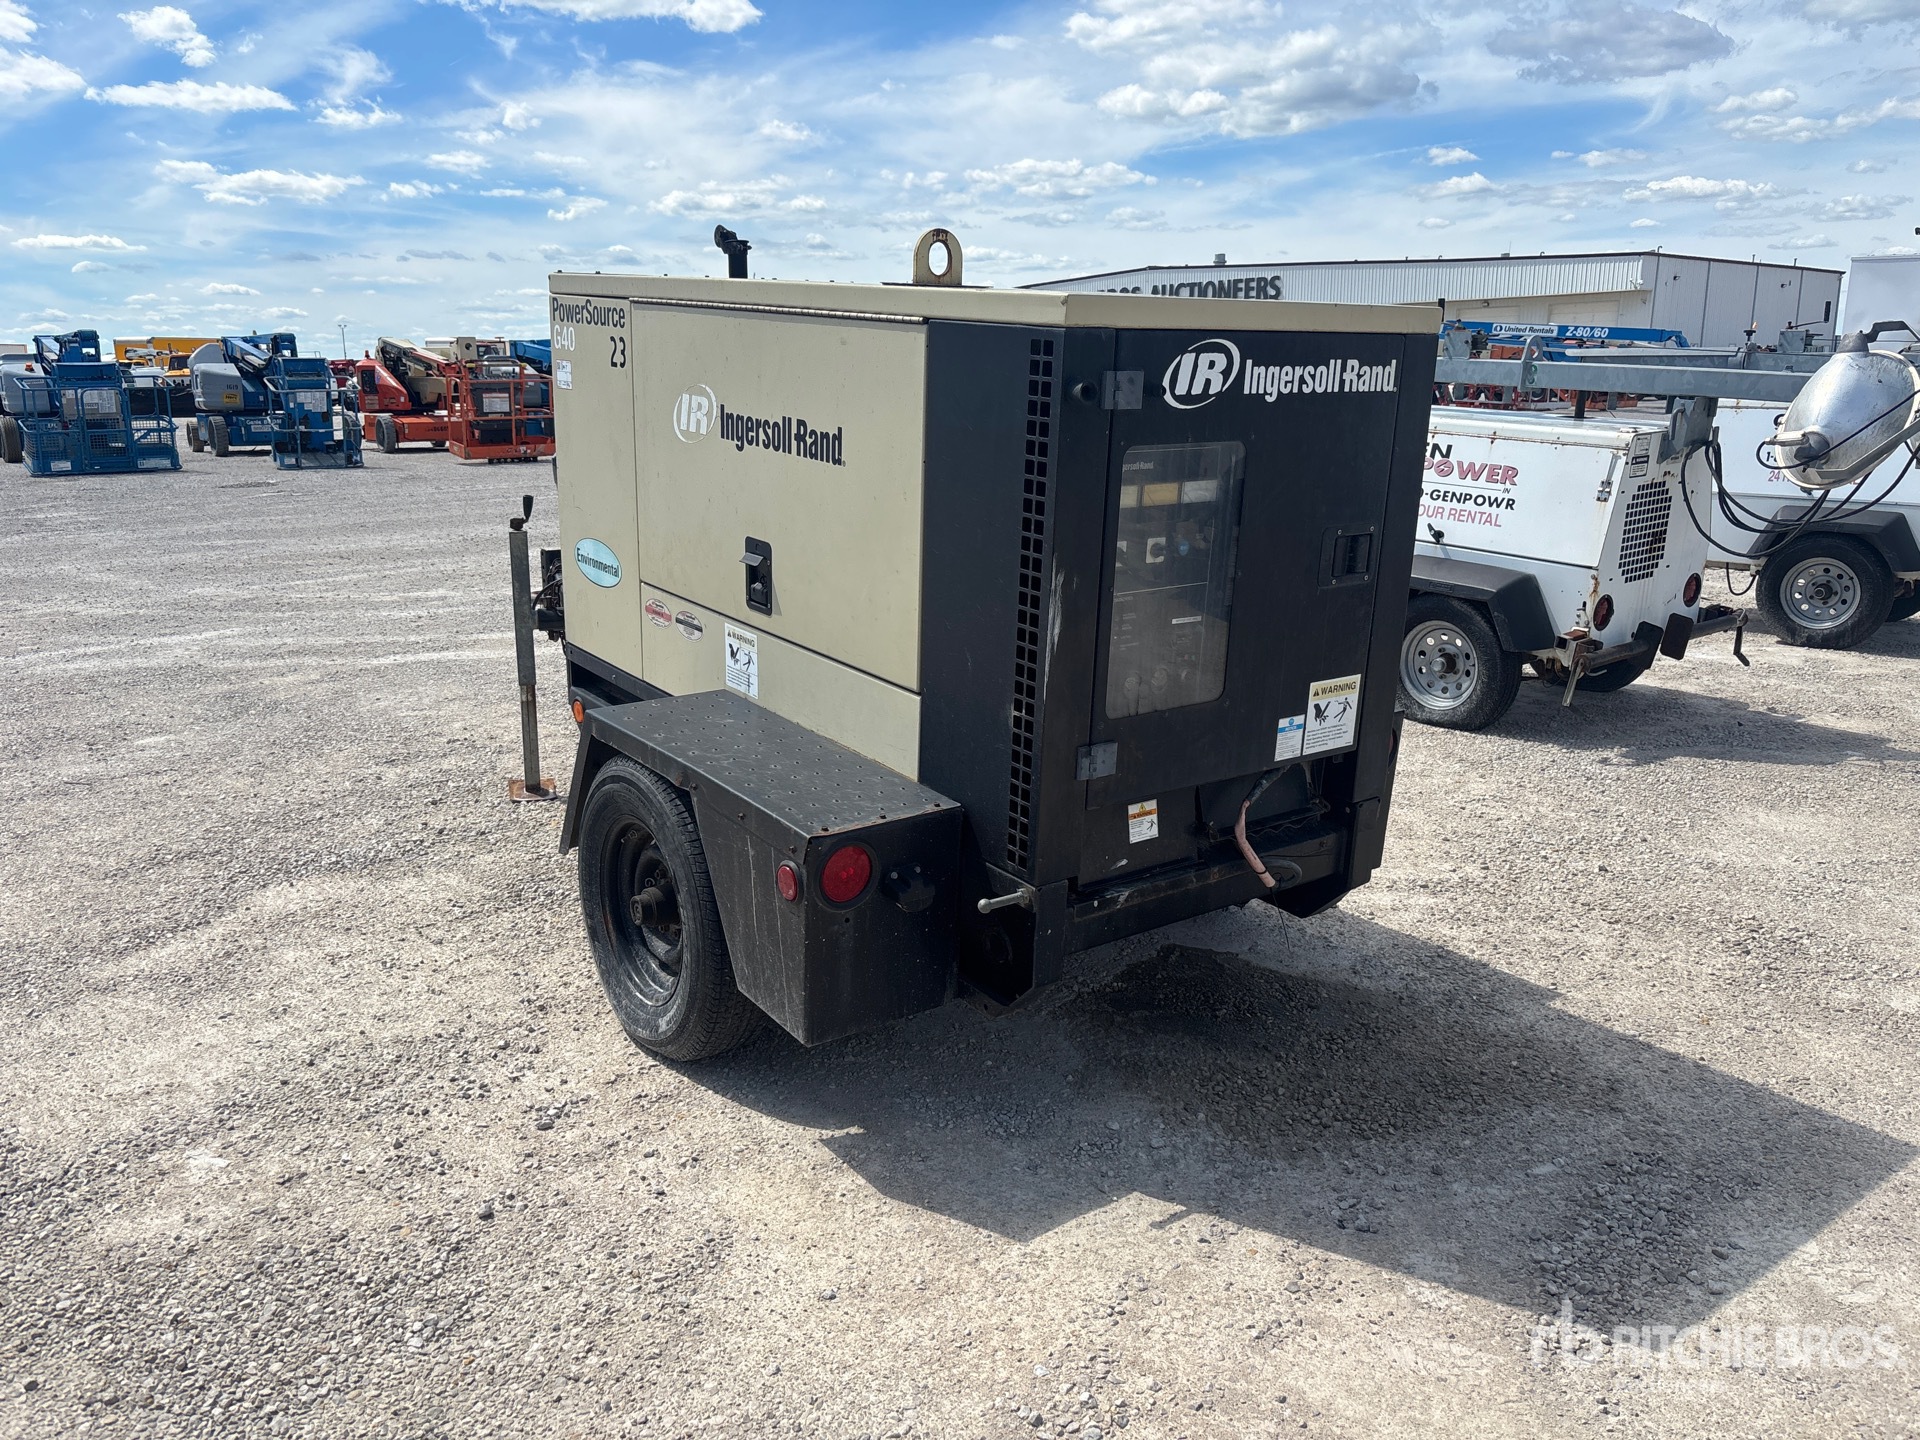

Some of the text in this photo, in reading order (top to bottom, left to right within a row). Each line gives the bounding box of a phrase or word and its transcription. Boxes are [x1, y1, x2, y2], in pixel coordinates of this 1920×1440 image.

[552, 297, 625, 328] PowerSource
[554, 325, 575, 351] G40
[1504, 326, 1555, 335] United Rentals
[1566, 327, 1609, 337] Z-80/60
[610, 336, 626, 368] 23
[1174, 352, 1228, 396] IR
[1448, 508, 1502, 528] RENTAL
[576, 547, 620, 579] Environmental
[732, 631, 755, 648] WARNING
[1321, 681, 1357, 696] WARNING
